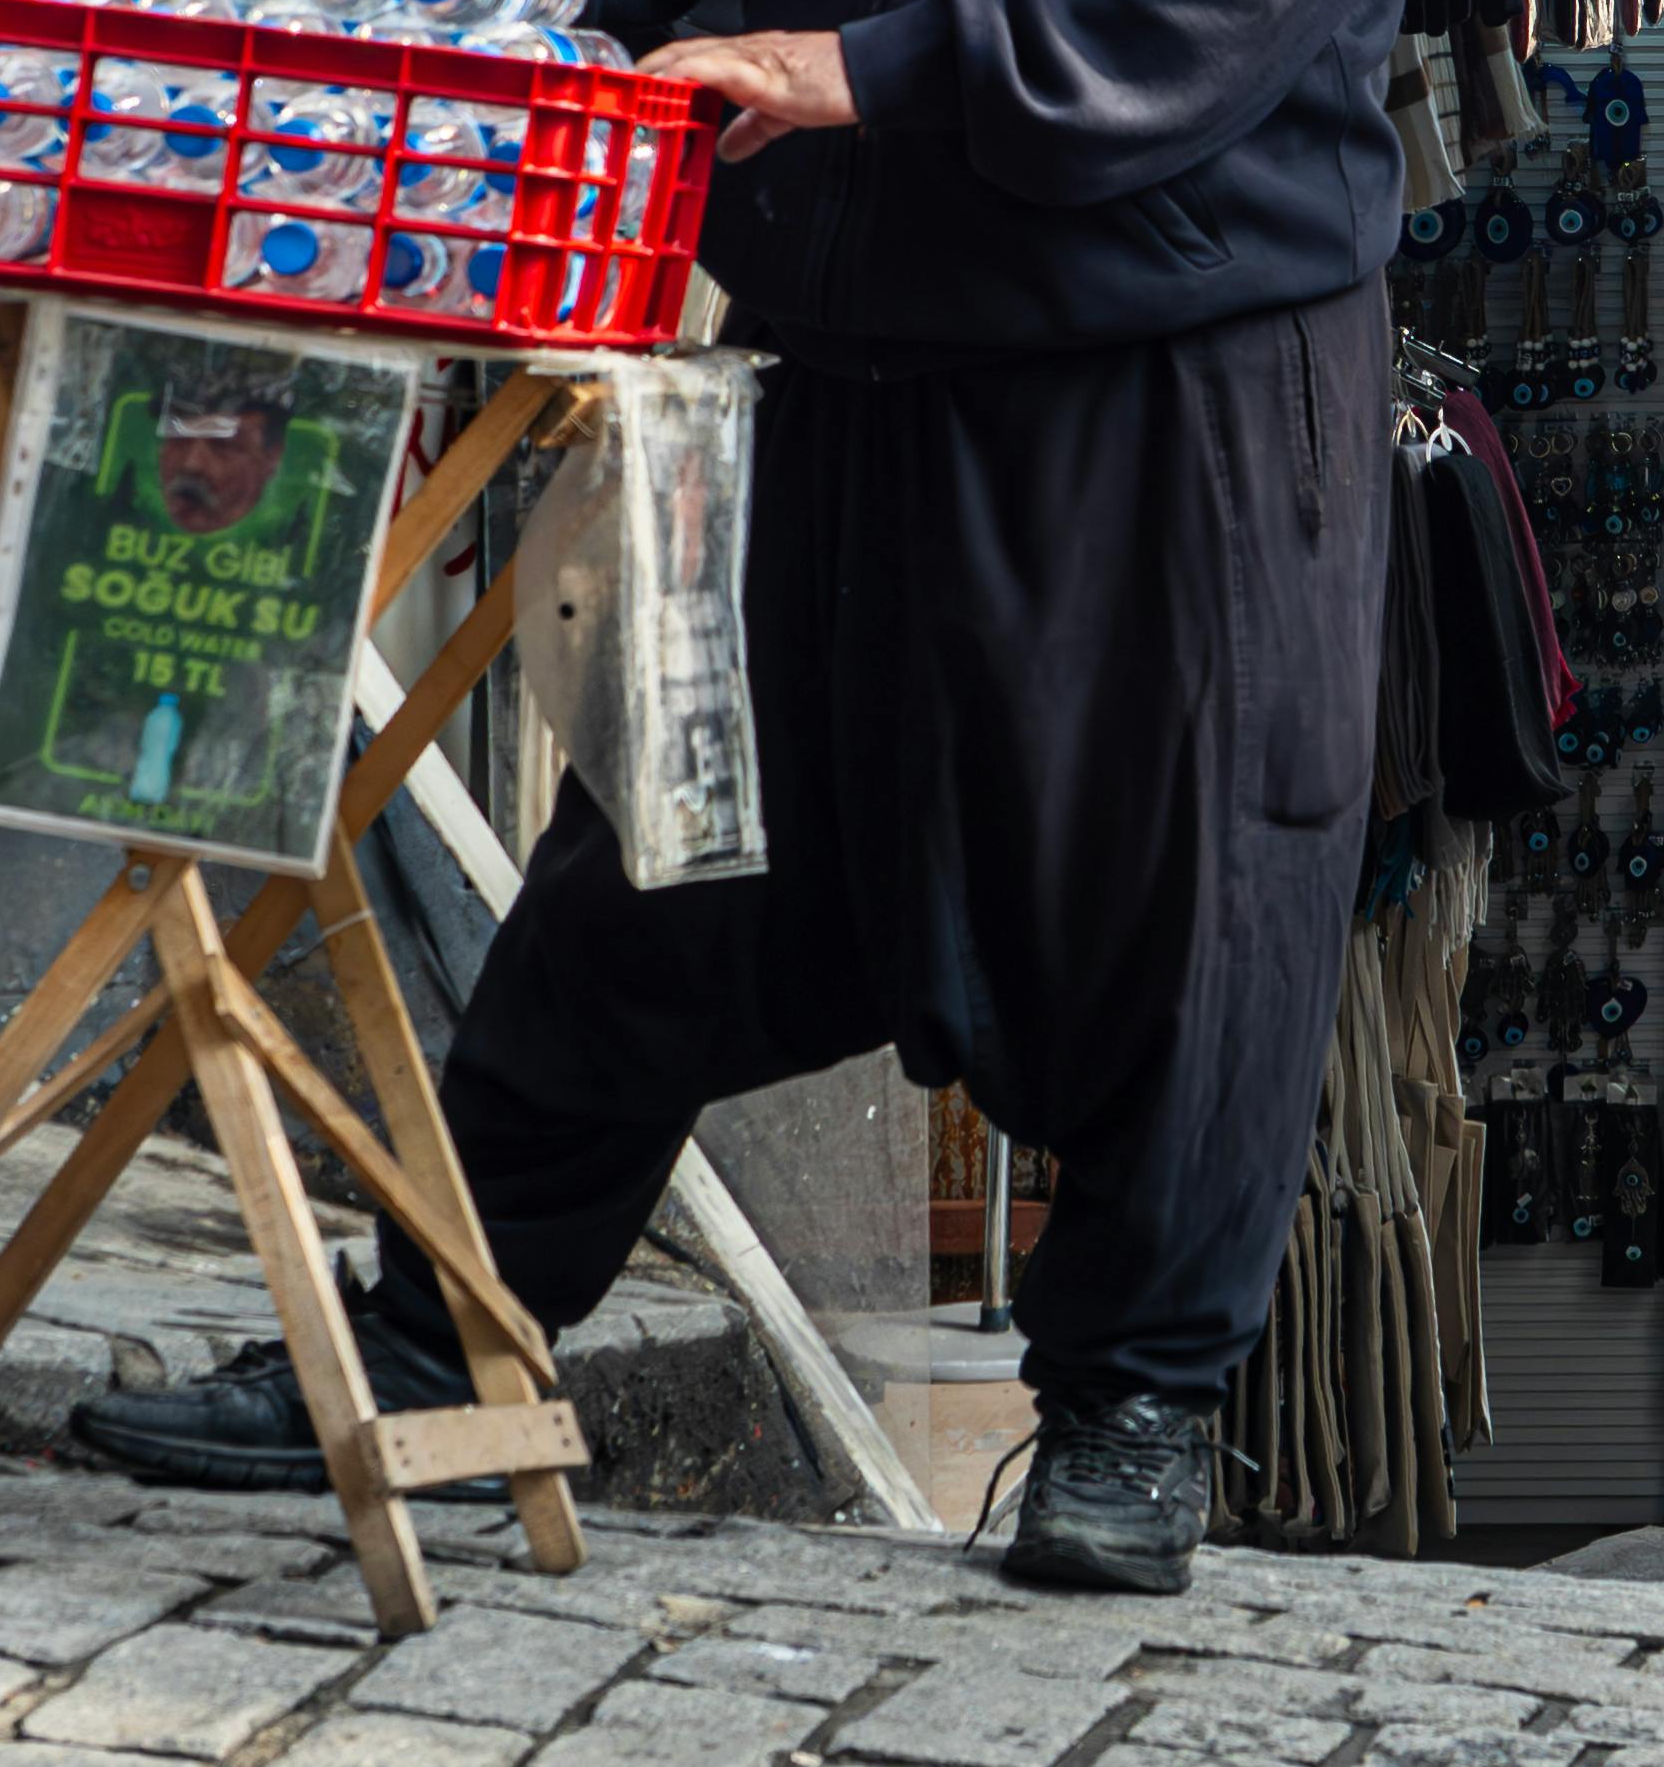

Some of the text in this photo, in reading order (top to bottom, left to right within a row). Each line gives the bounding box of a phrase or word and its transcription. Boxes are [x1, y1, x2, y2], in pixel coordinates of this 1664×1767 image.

[104, 522, 196, 573] BUZ
[61, 561, 320, 641] SOĞUK SU
[132, 650, 227, 697] 15 TL
